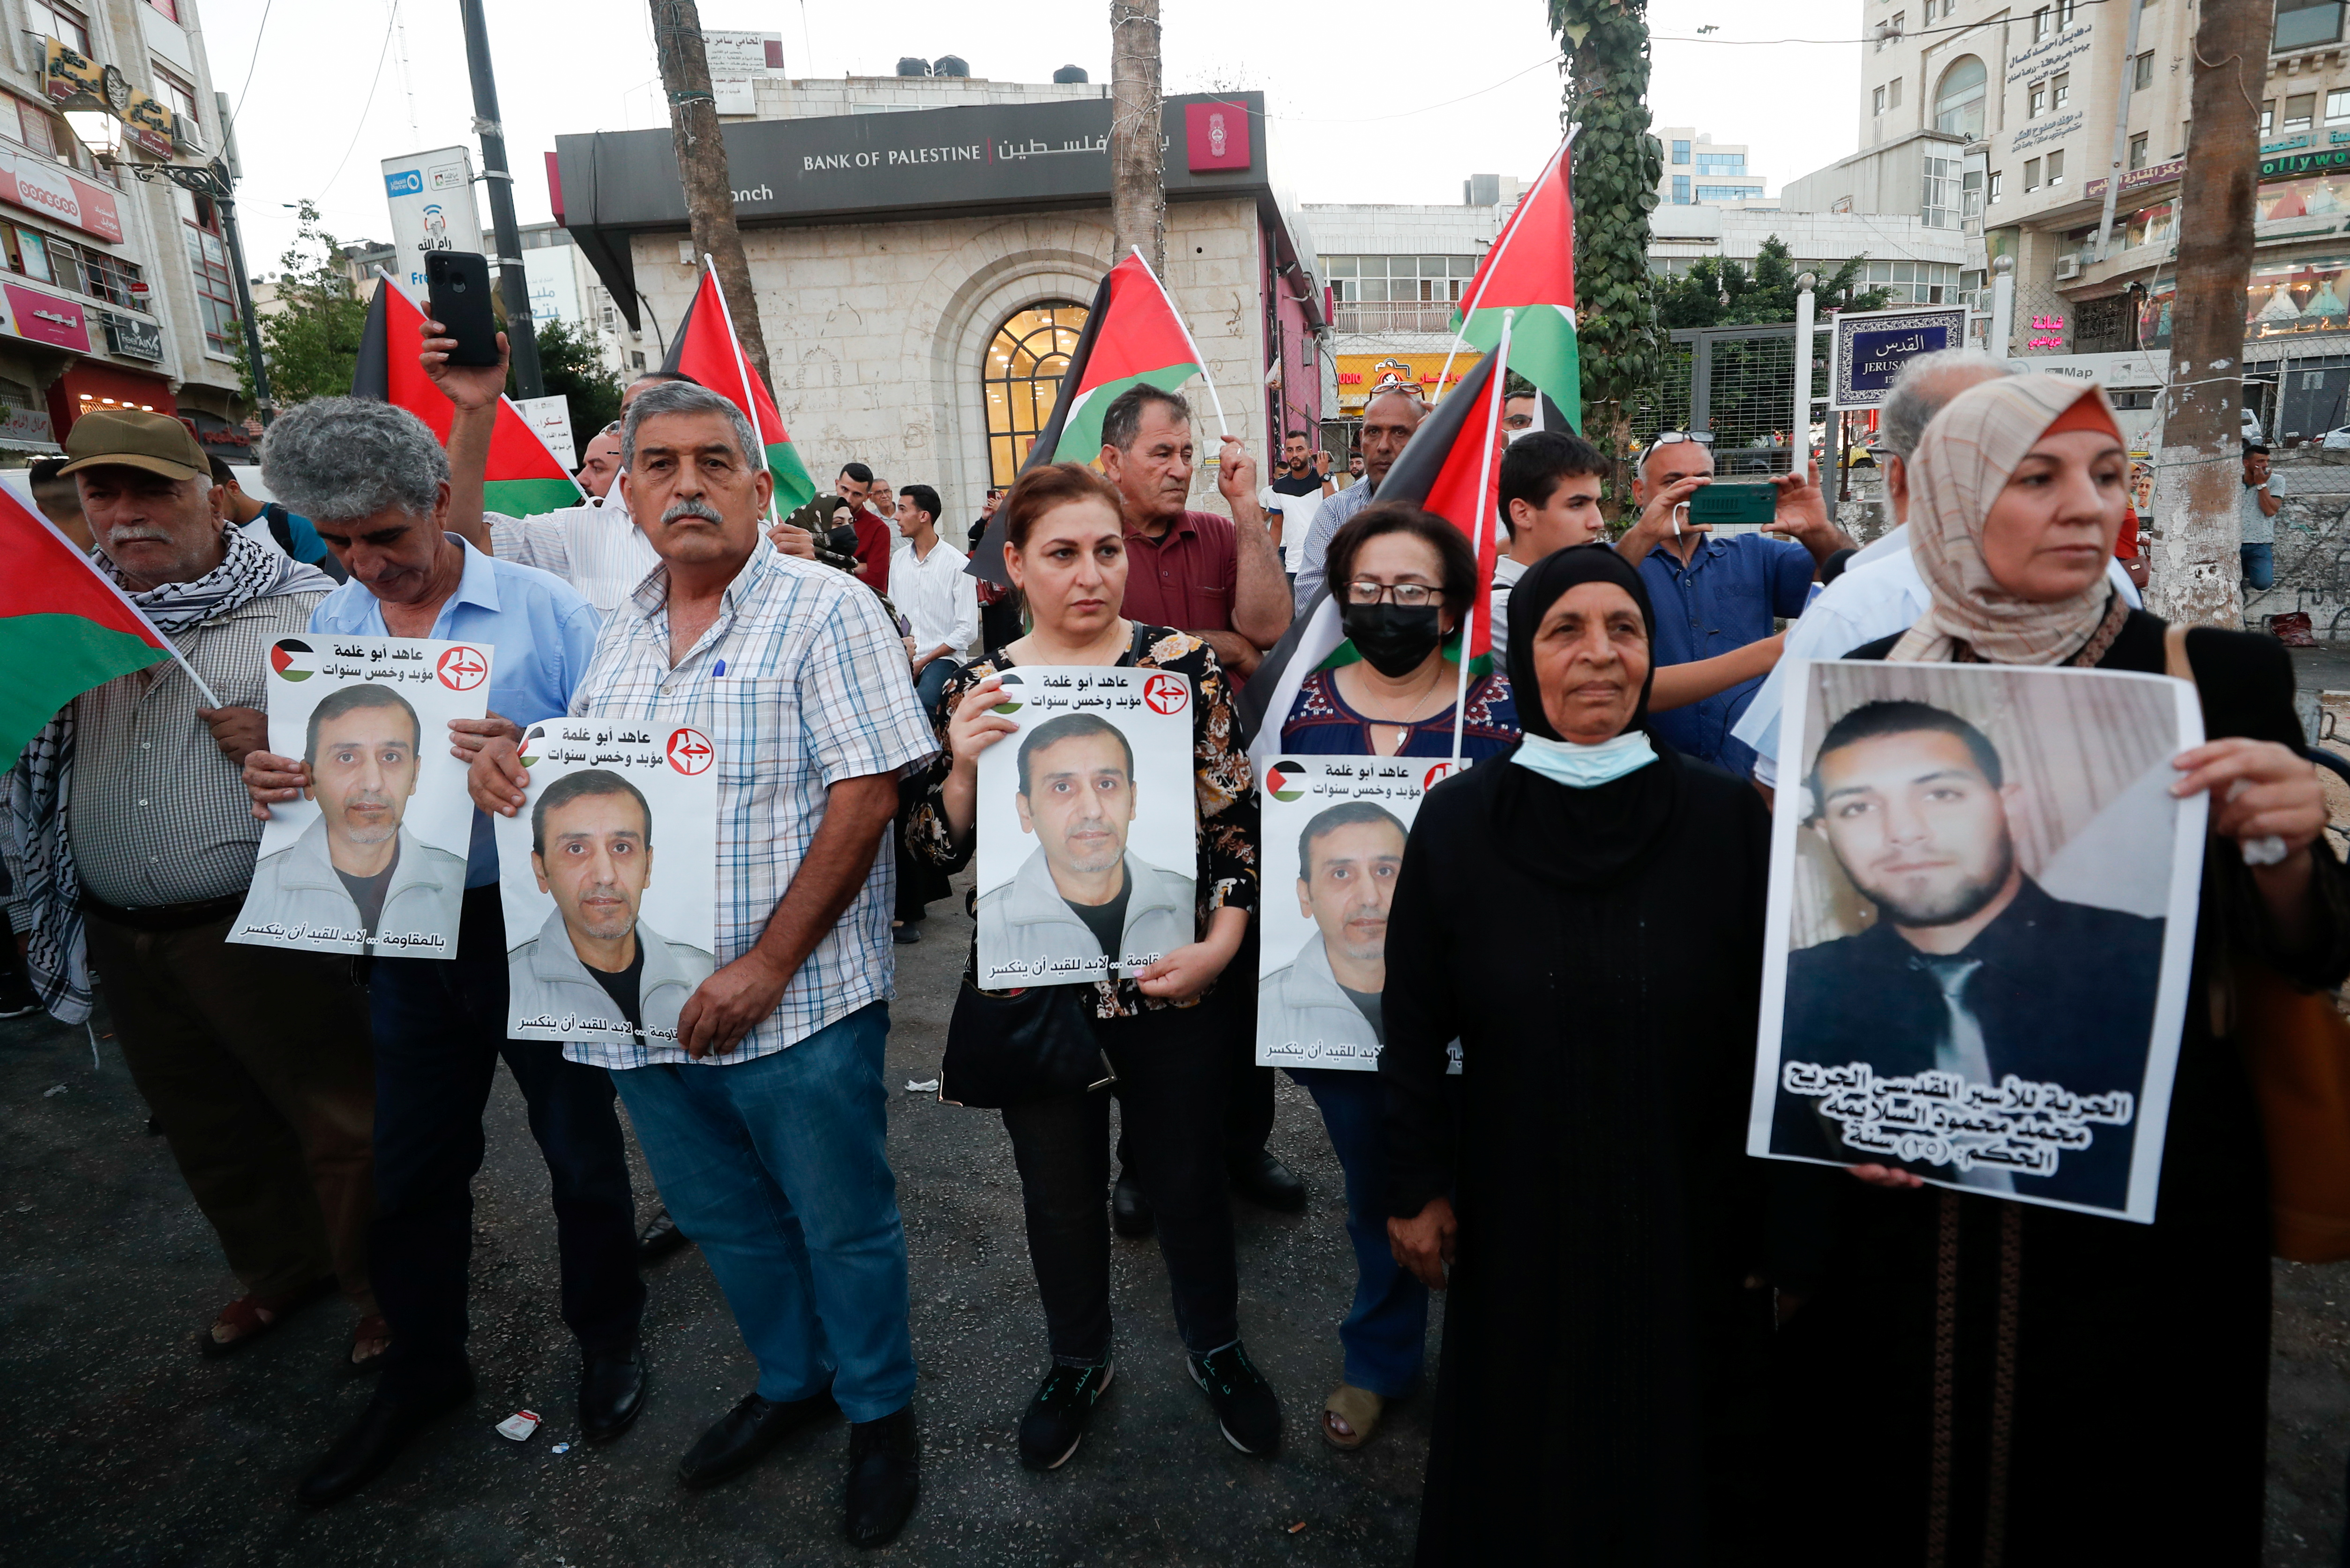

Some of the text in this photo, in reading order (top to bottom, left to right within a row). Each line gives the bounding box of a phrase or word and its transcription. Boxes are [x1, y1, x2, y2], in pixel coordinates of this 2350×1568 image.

[715, 36, 733, 46] سامر
[736, 36, 761, 49] المحامي
[2059, 28, 2084, 46] هديل
[2033, 38, 2058, 56] احمد
[2009, 48, 2032, 68] كمال
[998, 134, 1108, 161] فلسطين
[804, 145, 981, 171] BANK OF PALESTINE
[2125, 167, 2158, 184] المنارة
[2159, 163, 2184, 177] ركز
[21, 183, 77, 214] ooredoo
[418, 236, 452, 251] رام الله
[529, 286, 555, 300] ملي
[2032, 314, 2064, 333] شبانة
[121, 332, 137, 345] Feel
[1876, 334, 1924, 357] القدس
[2064, 367, 2093, 379] Map
[12, 413, 28, 434] الحاج
[31, 415, 46, 433] جمال
[335, 643, 423, 662] عاهد أبو غلمة
[322, 664, 434, 683] مؤبد وخمس سنوات
[1043, 672, 1129, 691] عاهد أبو غلمة
[1031, 694, 1141, 709] مؤبد وخمس سنوات
[562, 726, 651, 746] عاهد أبو غلمة
[547, 748, 664, 768] مؤبد وخمس سنوات
[1325, 762, 1409, 781] عاهد أبو غلمة
[1313, 783, 1421, 800] مؤبد وخمس سنوات
[240, 923, 285, 941] ينكسر
[288, 921, 306, 940] أن
[307, 928, 339, 944] للقيد
[383, 931, 445, 950] بالمقاومة
[988, 961, 1028, 978] ينكسر
[1032, 955, 1046, 975] أن
[1050, 958, 1080, 976] للقيد
[517, 1015, 557, 1031] ينكسر
[561, 1014, 575, 1030] أن
[578, 1019, 607, 1034] للقيد
[1265, 1043, 1304, 1060] ينكسر
[1308, 1040, 1322, 1059] أن
[1325, 1046, 1355, 1062] للقيد
[1789, 1065, 2127, 1118] الحرية للأسير المقدسي الجريح
[1935, 1110, 2008, 1136] محمود
[2015, 1121, 2087, 1142] محمد
[1849, 1127, 1897, 1149] سنة
